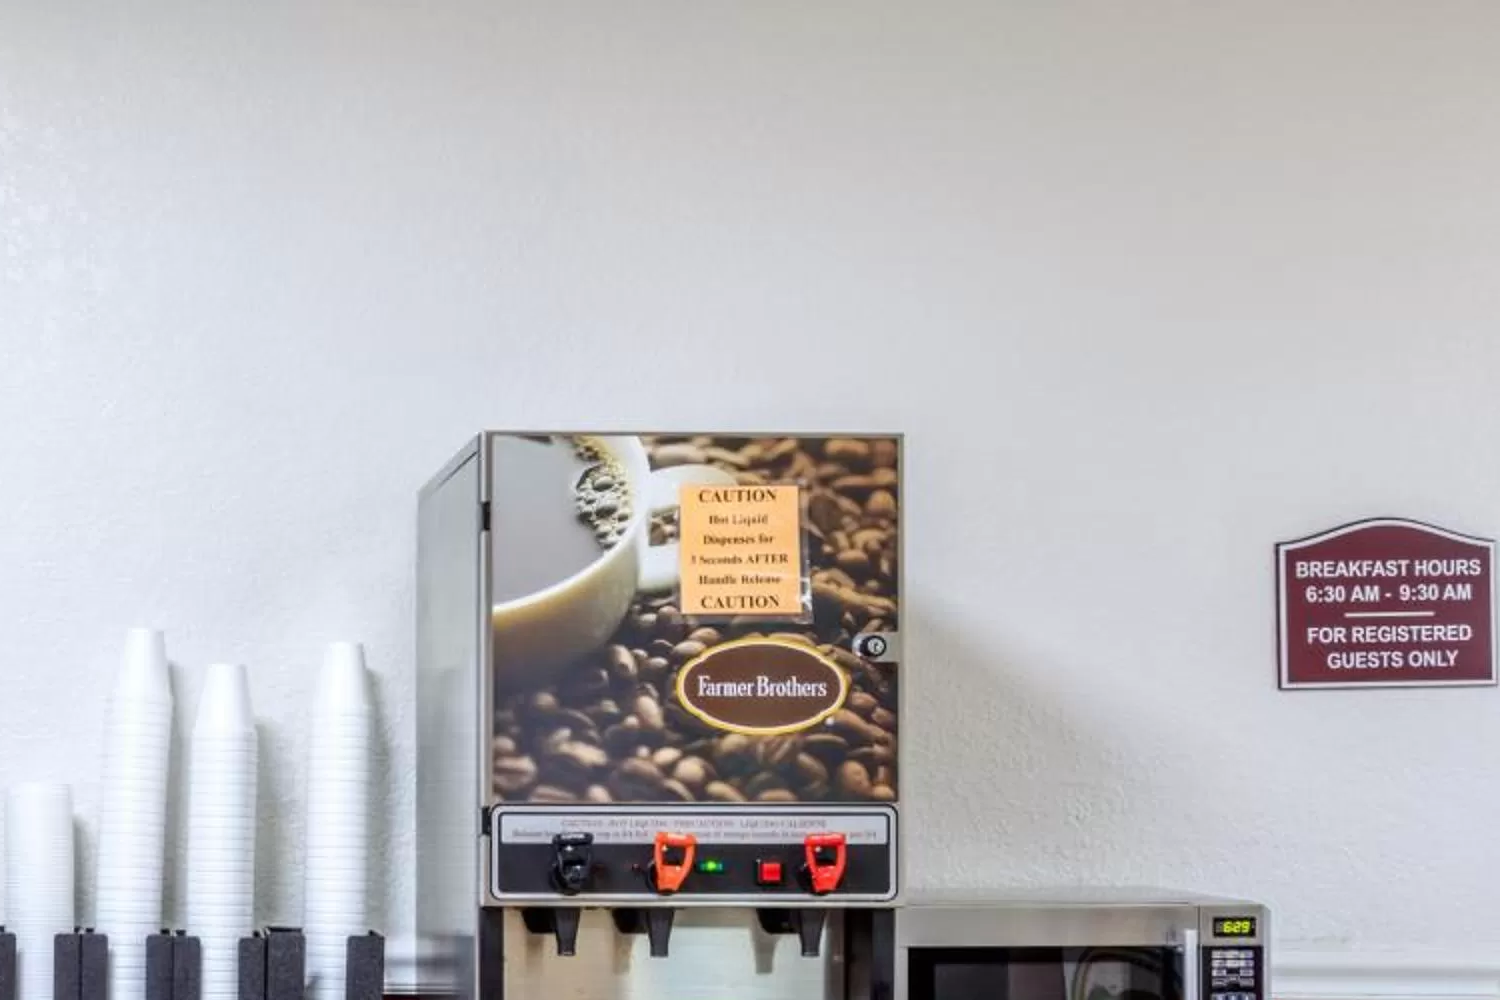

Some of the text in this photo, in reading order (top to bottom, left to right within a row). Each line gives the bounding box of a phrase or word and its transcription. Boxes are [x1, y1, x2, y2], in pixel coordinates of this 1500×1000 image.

[699, 489, 776, 502] CAUTION
[709, 514, 768, 527] Hot Liquid
[703, 533, 775, 546] Dispenses for
[699, 554, 742, 565] Seconds
[746, 553, 789, 564] AFTER
[1295, 559, 1481, 578] BREAKFAST HOURS
[699, 575, 781, 585] Handle Release
[1305, 586, 1345, 603] 6:30
[1350, 585, 1380, 602] AM
[1399, 584, 1439, 601] 9:30
[1443, 583, 1472, 600] AM
[701, 595, 780, 609] CAUTION
[1307, 624, 1473, 644] FOR REGISTERED
[1327, 650, 1459, 669] GUESTS ONLY
[697, 674, 827, 697] Farmer Brothers
